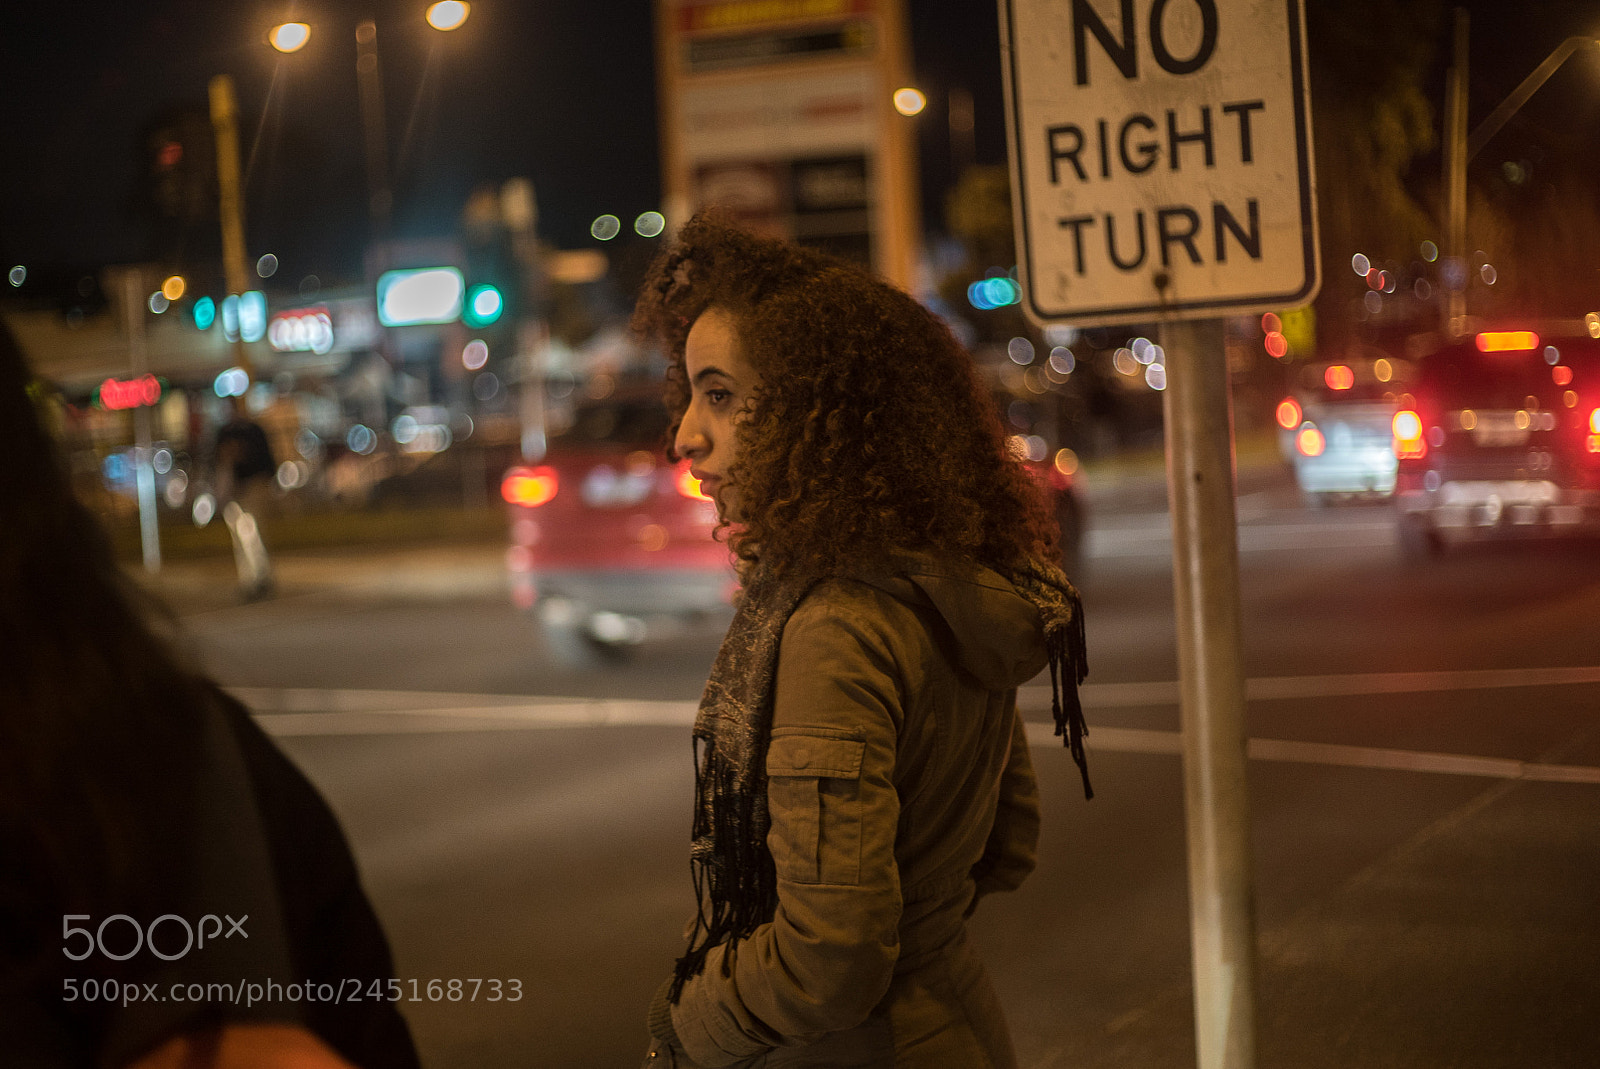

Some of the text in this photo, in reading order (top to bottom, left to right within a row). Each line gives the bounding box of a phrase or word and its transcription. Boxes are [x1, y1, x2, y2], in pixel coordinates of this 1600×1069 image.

[1072, 0, 1219, 86] NO
[1046, 100, 1265, 186] RIGHT
[1058, 198, 1262, 277] TURN
